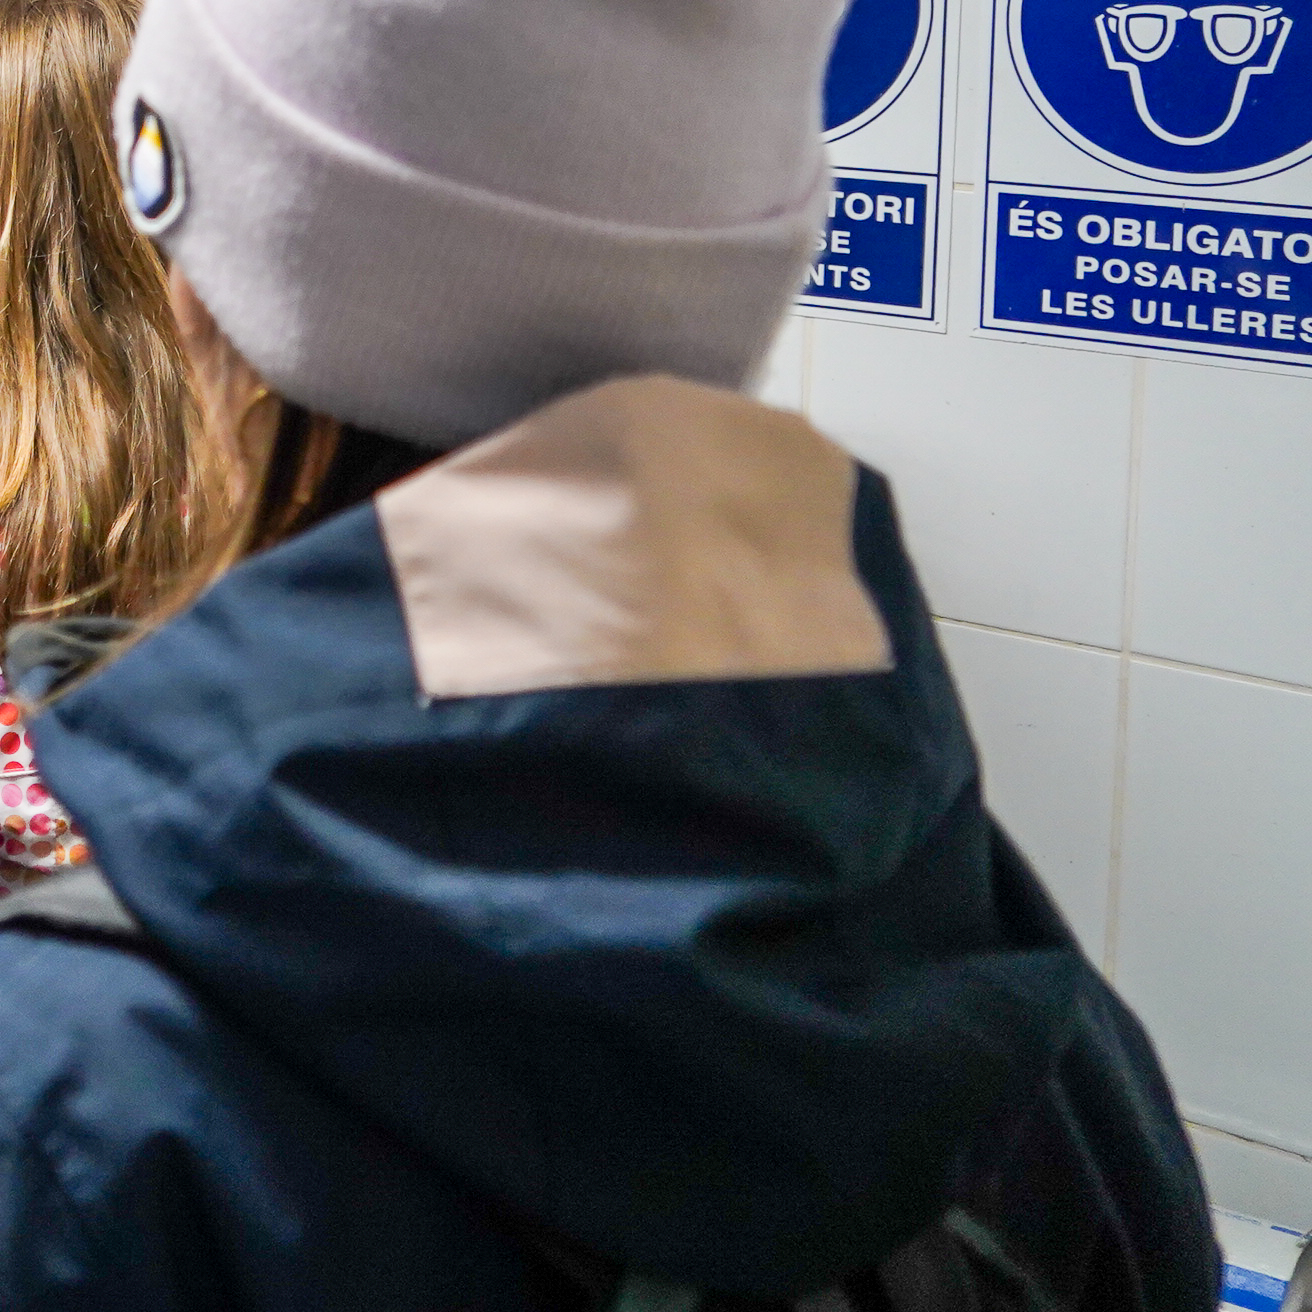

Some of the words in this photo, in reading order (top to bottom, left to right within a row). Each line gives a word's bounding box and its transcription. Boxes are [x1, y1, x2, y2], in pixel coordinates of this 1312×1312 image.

[1008, 200, 1064, 241] ÉS
[1077, 214, 1312, 265] OBLIGATO
[1076, 255, 1292, 302] POSAR-SE
[1040, 288, 1116, 320] LES
